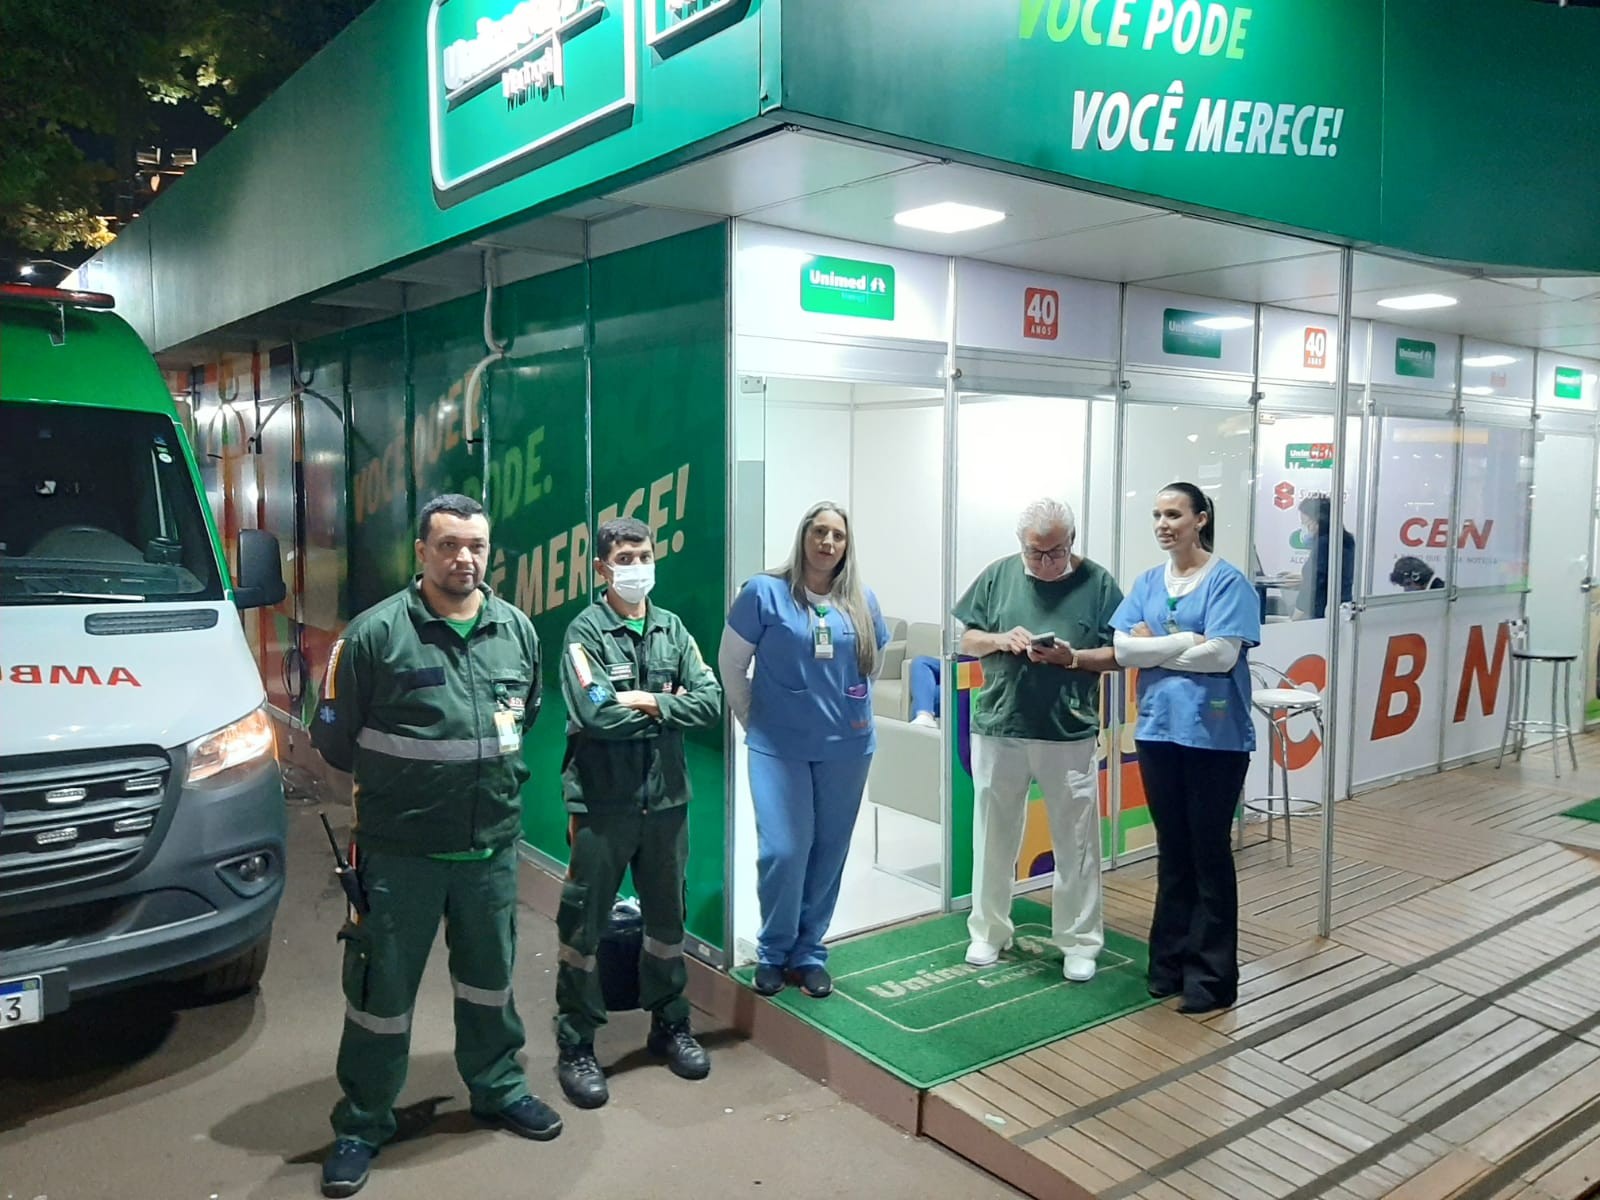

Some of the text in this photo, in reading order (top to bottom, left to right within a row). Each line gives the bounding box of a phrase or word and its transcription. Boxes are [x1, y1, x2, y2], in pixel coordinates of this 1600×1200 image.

[1142, 0, 1252, 60] PODE
[1071, 80, 1345, 158] VOCÊ MERECE!
[809, 269, 866, 291] Unimed
[1027, 293, 1056, 326] 40
[1305, 332, 1325, 357] 40
